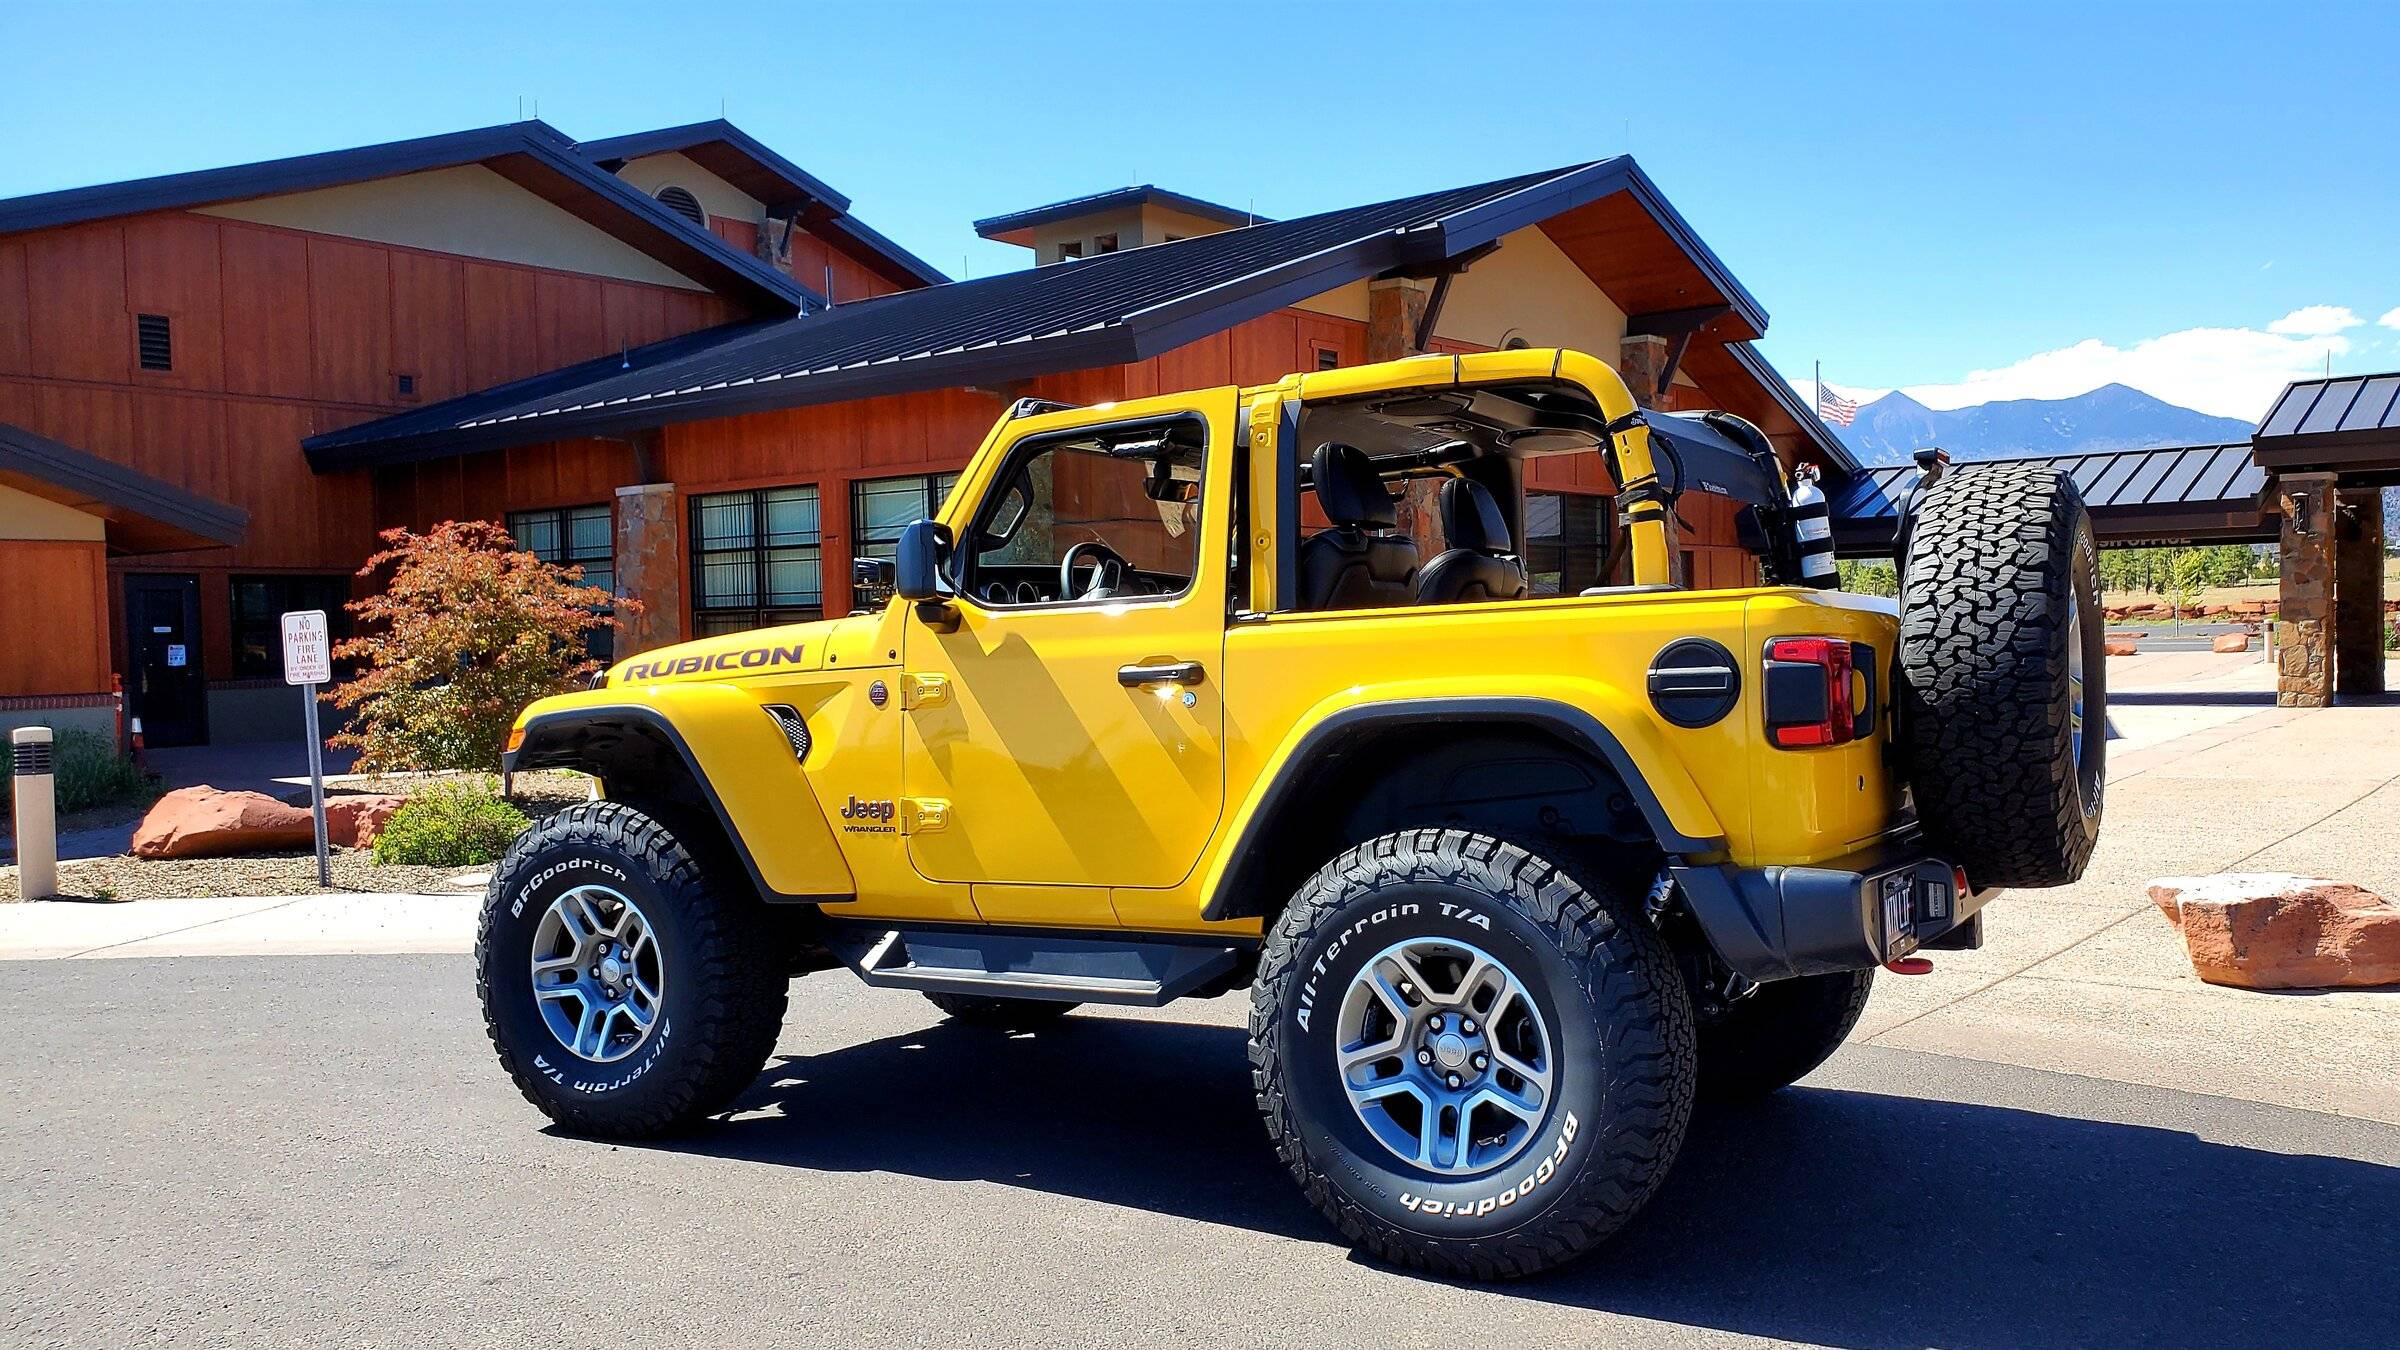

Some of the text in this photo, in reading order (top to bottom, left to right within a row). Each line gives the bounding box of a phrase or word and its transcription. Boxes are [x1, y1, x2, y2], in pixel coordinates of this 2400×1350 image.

[288, 630, 323, 643] PARKING
[299, 619, 311, 630] NO
[296, 654, 318, 664] LANE
[297, 644, 315, 654] FIRE
[623, 644, 805, 682] RUBICON
[840, 795, 895, 823] Jeep
[843, 825, 896, 833] WRANGLER
[511, 858, 627, 919] BFGoodrich
[1297, 901, 1491, 1033] All-Terrain T/A
[533, 1017, 671, 1094] All-Terrain T/A
[1399, 1110, 1580, 1218] BFGoodrich
